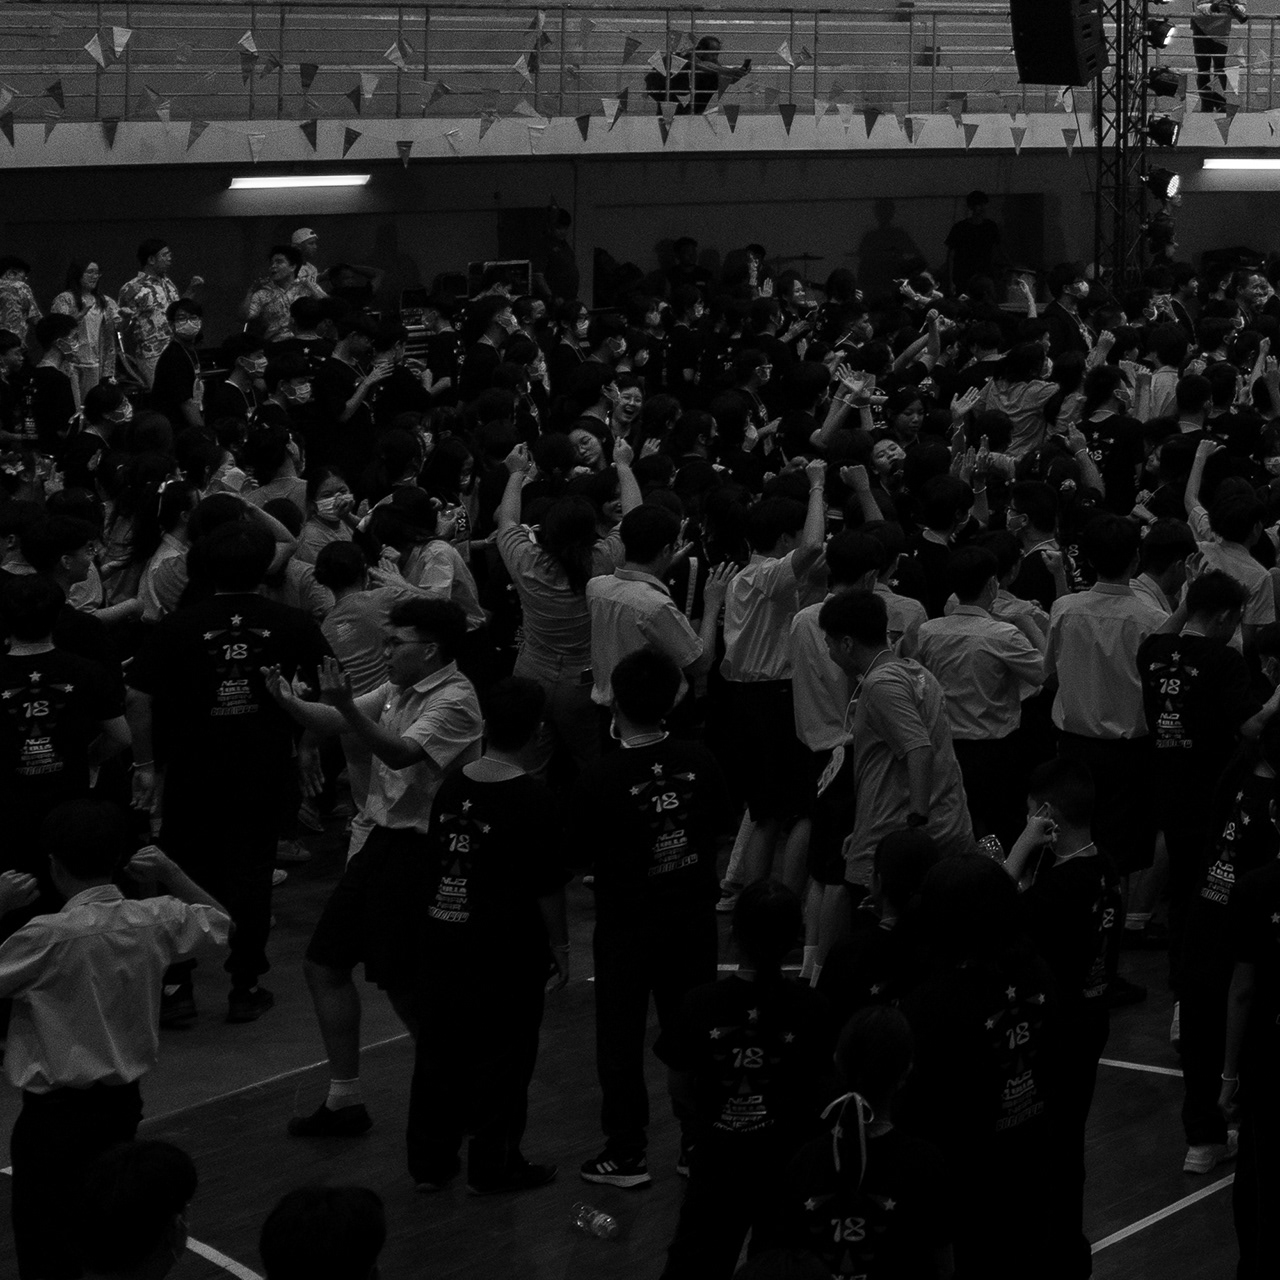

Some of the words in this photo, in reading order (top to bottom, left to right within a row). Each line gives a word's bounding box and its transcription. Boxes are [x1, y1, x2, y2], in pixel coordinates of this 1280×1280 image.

[222, 643, 248, 660] 18
[1160, 678, 1180, 694] 18
[22, 700, 50, 718] 18
[651, 792, 680, 813] 18
[1223, 822, 1235, 840] 18
[449, 833, 470, 852] 18
[1005, 1020, 1030, 1050] 18
[732, 1047, 764, 1069] 18
[830, 1217, 866, 1243] 18
